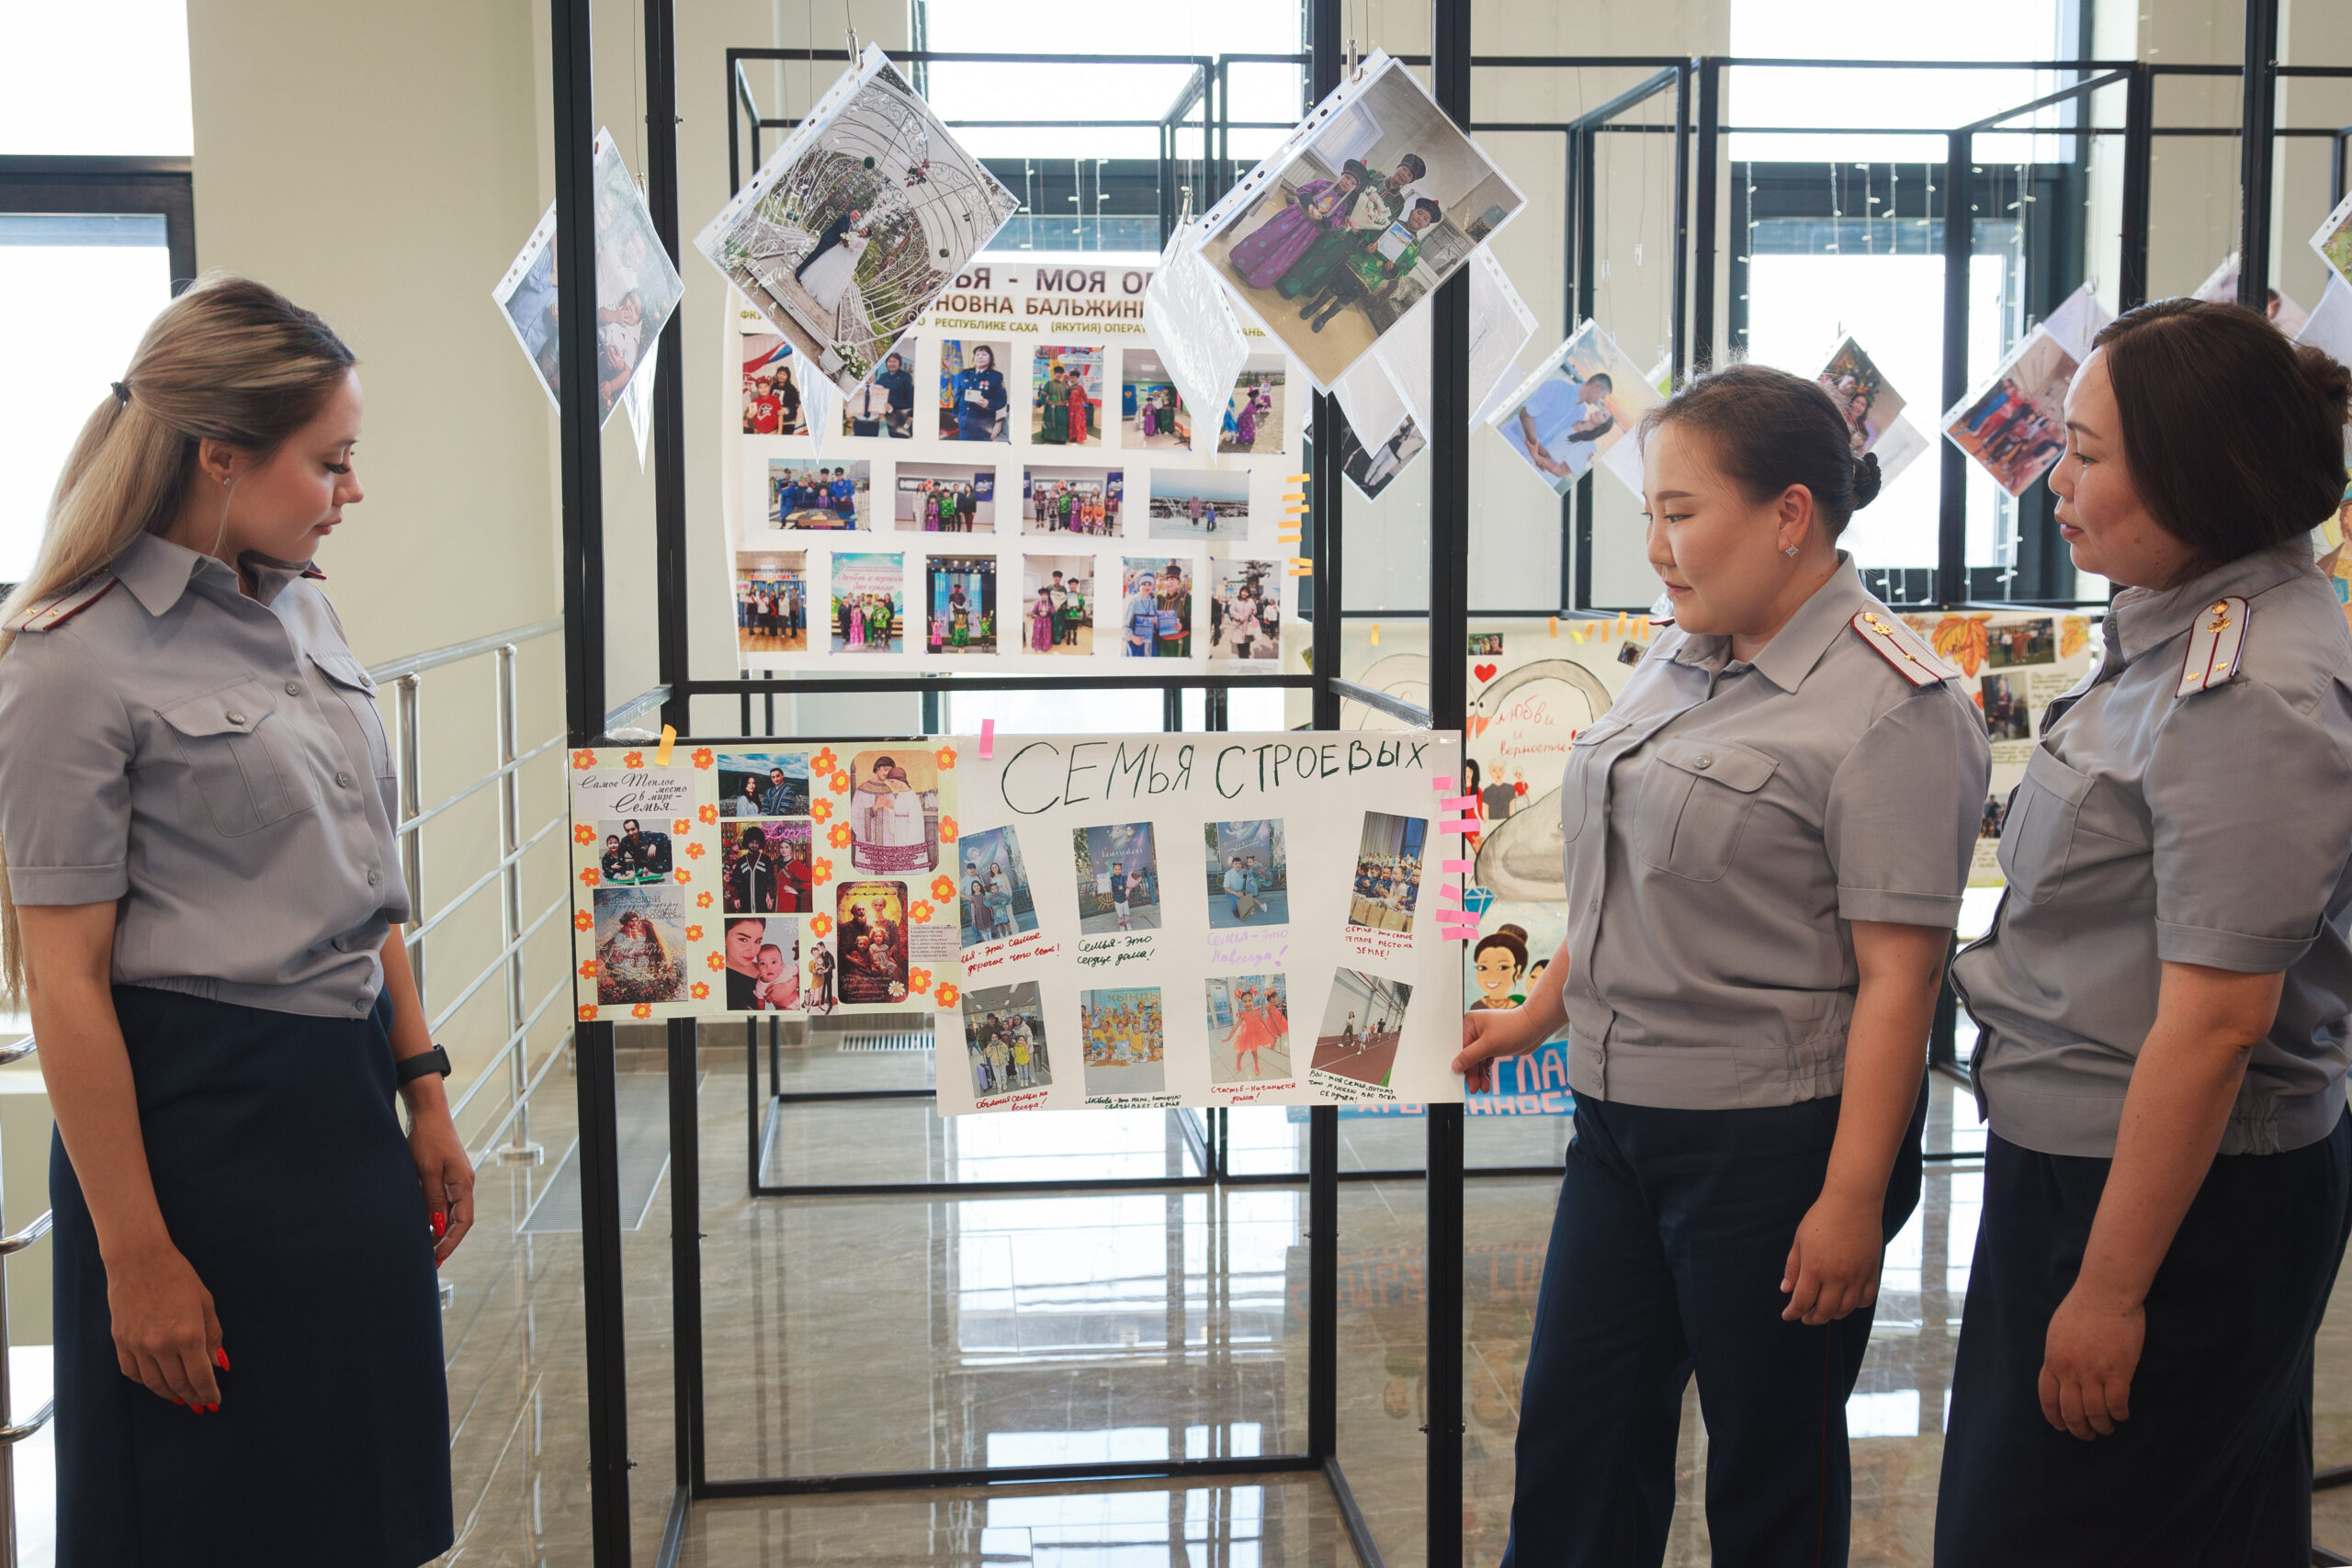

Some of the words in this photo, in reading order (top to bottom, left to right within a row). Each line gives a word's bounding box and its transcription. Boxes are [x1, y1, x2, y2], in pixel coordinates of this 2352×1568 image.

[1035, 268, 1106, 292] МОЯ
[1121, 271, 1149, 295] О
[930, 293, 1014, 315] НОВНА
[1024, 297, 1144, 319] БАЛЬЖИН
[934, 318, 1007, 331] РЕСПУБЛИКЕ
[1009, 321, 1039, 333] САХА
[1050, 322, 1102, 334] (ЯКУТИЯ)
[578, 774, 619, 789] Самое
[621, 773, 675, 788] Теплое
[1001, 741, 1195, 815] СЕМЬЯ
[1216, 739, 1430, 799] СТРОЕВЫХ
[639, 790, 645, 801] в
[648, 794, 673, 804] мире
[655, 785, 687, 794] место
